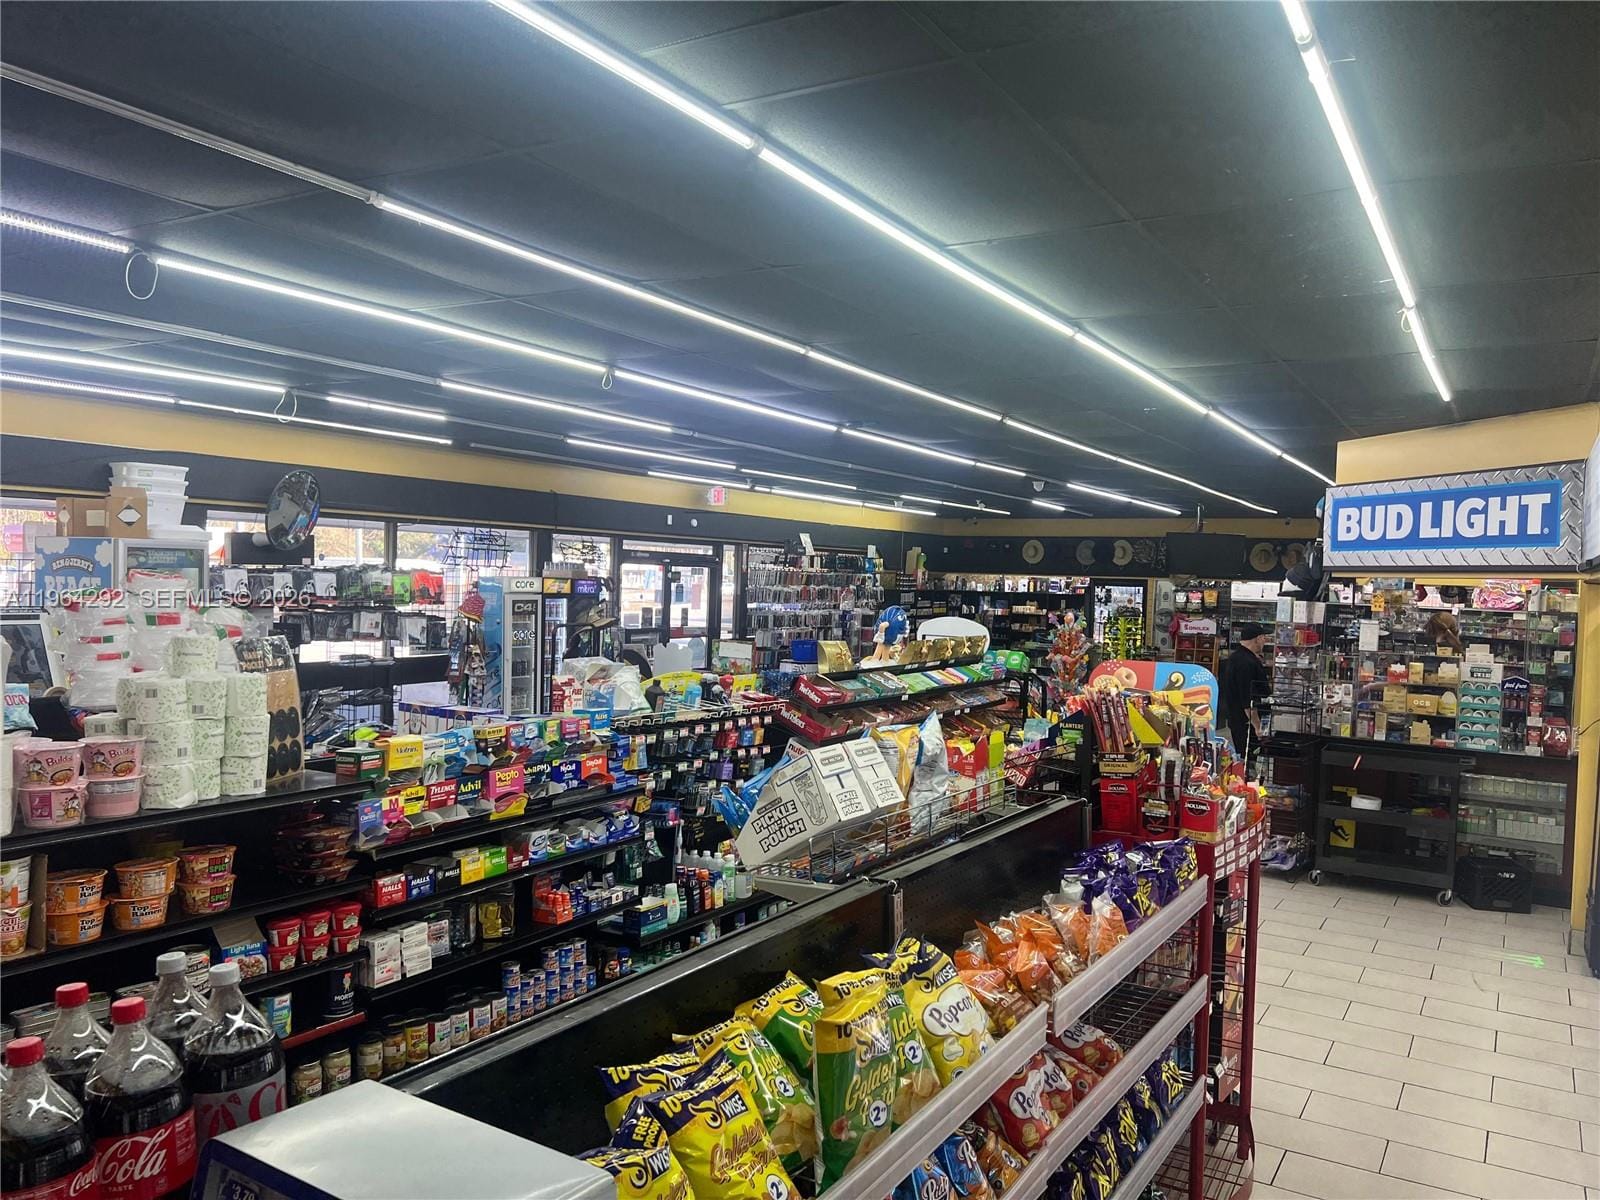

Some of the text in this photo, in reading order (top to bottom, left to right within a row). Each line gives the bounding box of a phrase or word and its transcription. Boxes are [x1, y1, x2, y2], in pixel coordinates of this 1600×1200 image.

[1337, 493, 1552, 542] BUD LIGHT
[515, 580, 535, 589] core
[513, 630, 536, 641] core
[1059, 722, 1084, 730] PLANTERS
[495, 769, 519, 781] Pepto
[430, 783, 456, 795] TYLENOL
[458, 780, 482, 795] Advil
[388, 797, 399, 809] M
[752, 799, 799, 835] PICKLE
[533, 836, 545, 846] BC
[759, 819, 808, 853] POUCH
[411, 876, 431, 886] HALLS
[79, 885, 97, 893] Top
[79, 889, 102, 899] Ram
[382, 883, 402, 894] HALLS
[130, 904, 150, 913] Top
[131, 908, 163, 918] Ramen
[79, 918, 97, 926] Top
[79, 922, 102, 932] Ram
[229, 942, 261, 956] Light Tuna
[934, 963, 958, 989] WISE
[844, 1060, 898, 1113] Golden
[720, 1092, 747, 1120] WISE
[632, 1115, 652, 1141] FREE
[99, 1128, 174, 1185] Cola
[108, 1183, 134, 1192] TASTE
